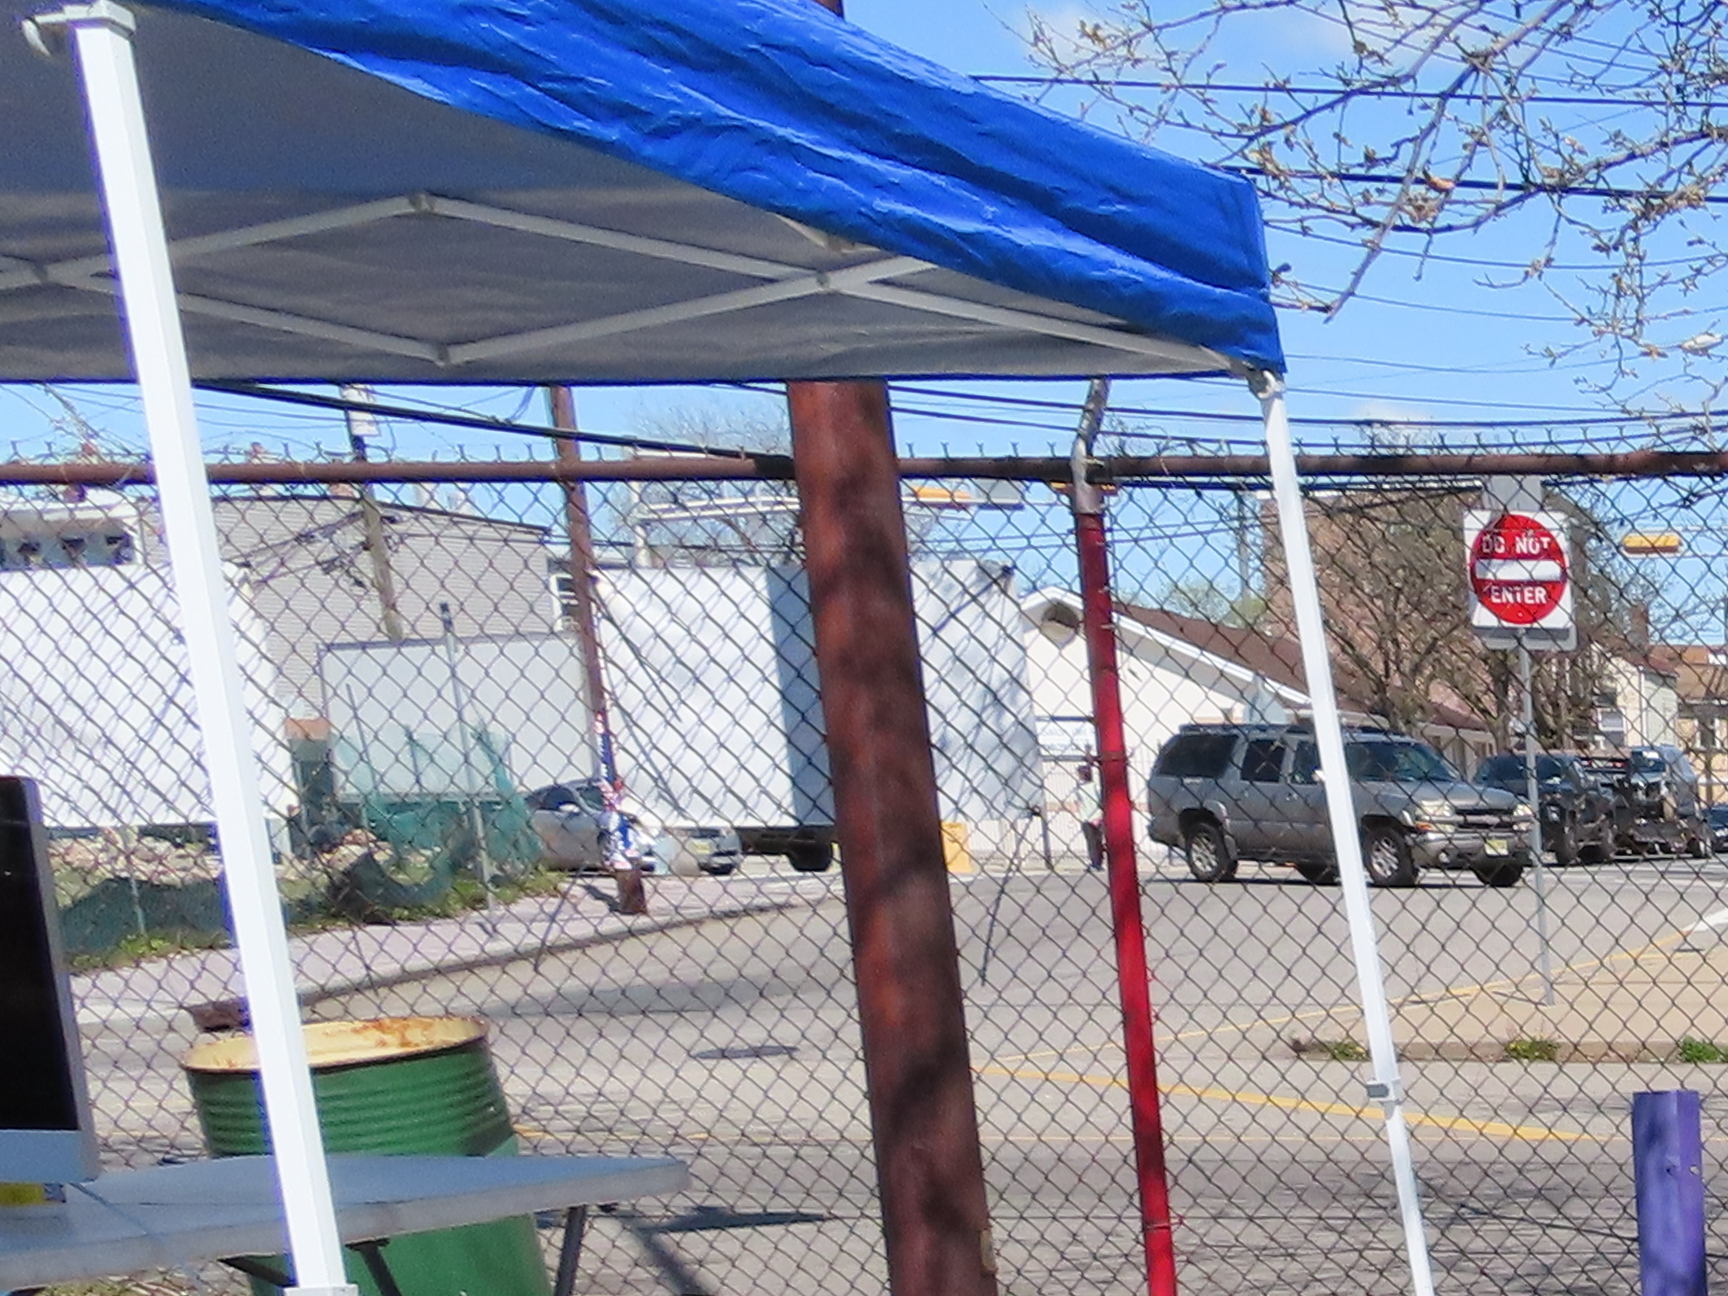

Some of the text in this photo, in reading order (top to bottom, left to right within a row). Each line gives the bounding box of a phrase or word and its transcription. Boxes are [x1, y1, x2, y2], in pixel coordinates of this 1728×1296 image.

[1482, 535, 1551, 555] DO NOT
[1490, 585, 1548, 604] ENTER
